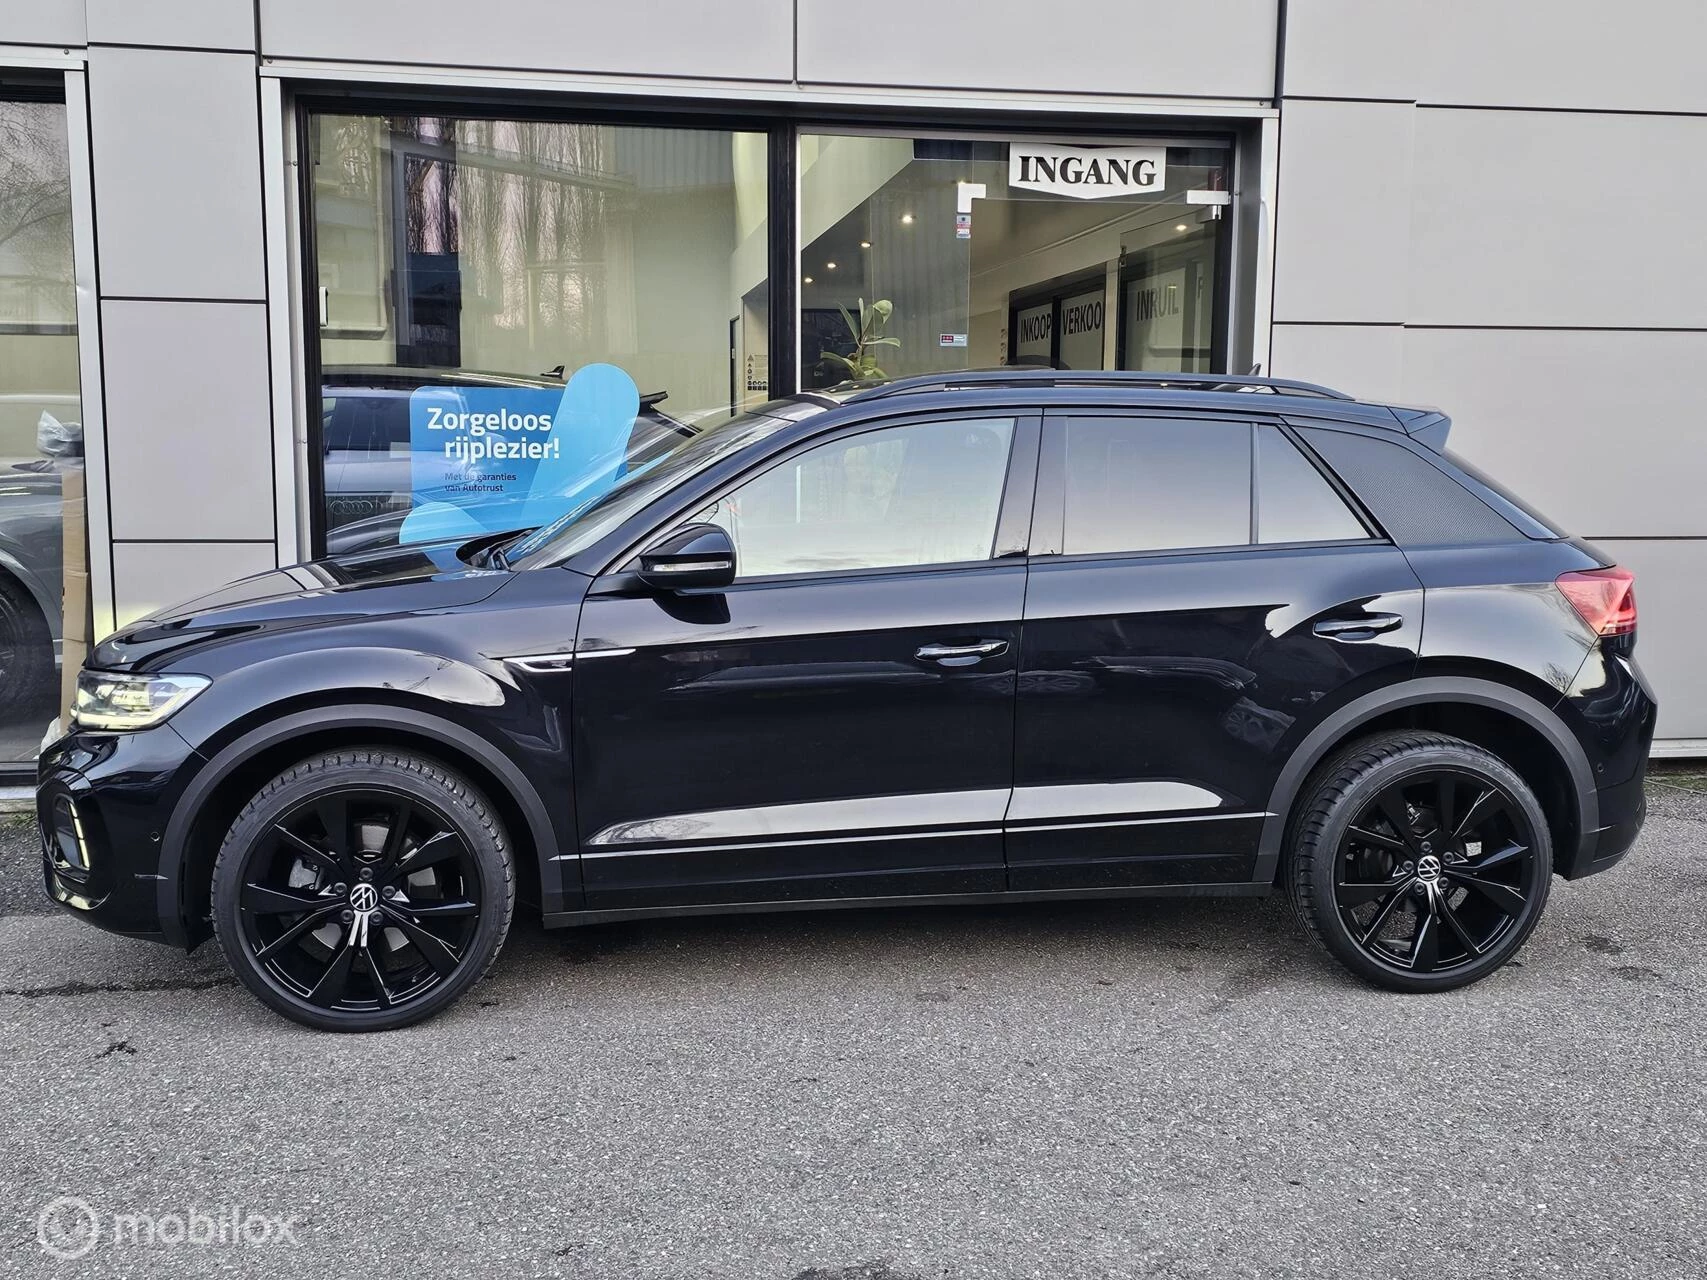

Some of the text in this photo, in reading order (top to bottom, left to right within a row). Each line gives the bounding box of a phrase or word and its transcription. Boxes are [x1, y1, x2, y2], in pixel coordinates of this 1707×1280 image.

[1018, 155, 1157, 187] INGANG
[1062, 301, 1103, 335] VERKOO
[1136, 284, 1179, 322] INRUIL
[1020, 313, 1052, 344] INKOOP
[427, 407, 552, 436] Zorgeloos
[444, 436, 560, 464] rijplezier!
[444, 473, 463, 481] Met
[477, 473, 517, 482] garanties
[463, 484, 504, 492] Autotrust
